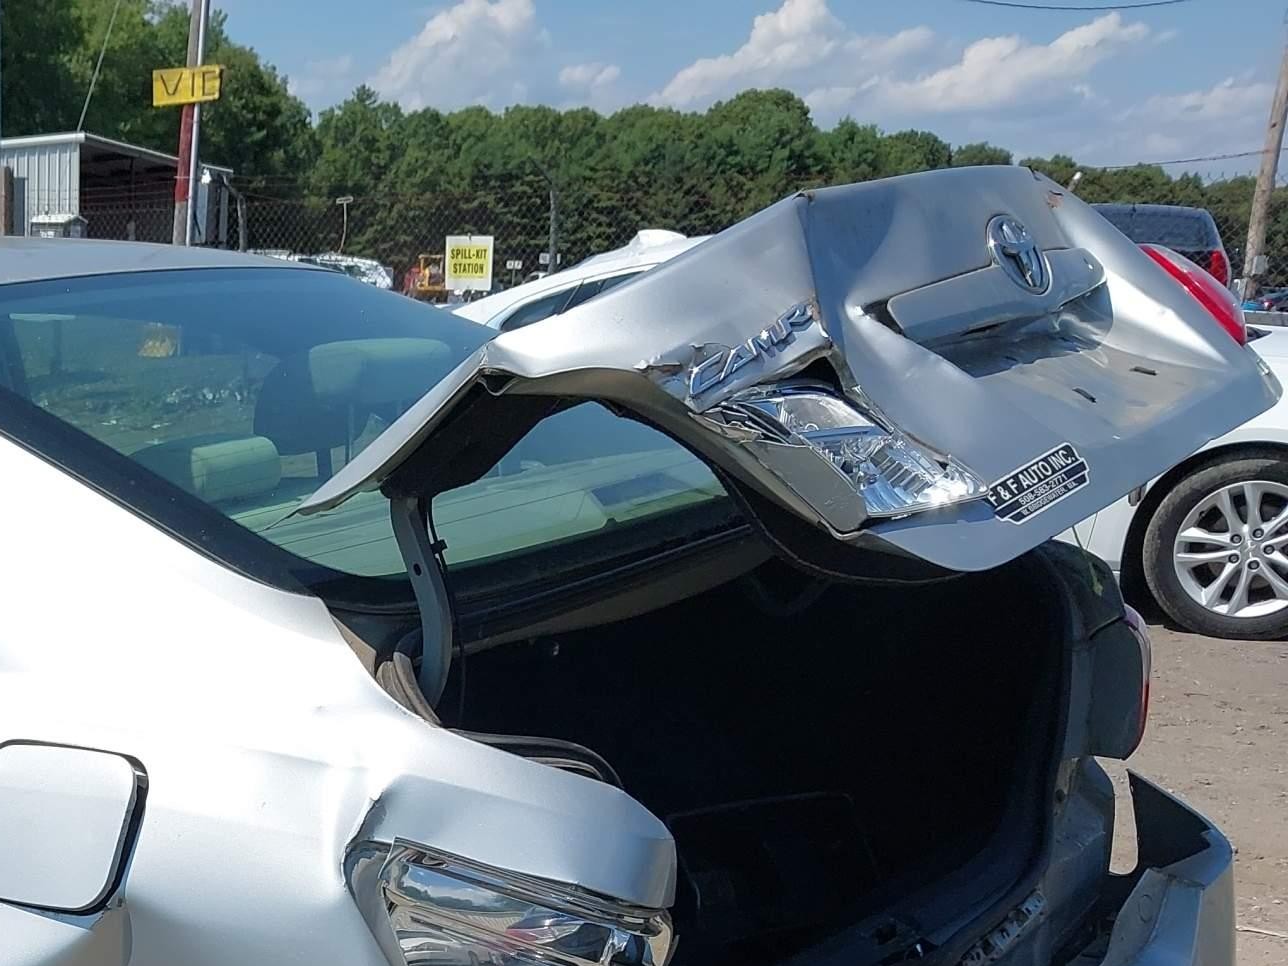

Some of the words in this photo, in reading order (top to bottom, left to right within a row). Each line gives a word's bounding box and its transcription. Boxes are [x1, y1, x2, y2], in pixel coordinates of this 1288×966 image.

[450, 248, 488, 260] SPILL-KIT
[452, 260, 484, 274] STATION
[690, 303, 814, 397] CAMR
[987, 491, 998, 506] F
[998, 485, 1012, 500] &
[1006, 479, 1019, 494] F
[1018, 461, 1052, 489] AUTO
[1047, 449, 1076, 472] INC.
[1018, 474, 1068, 505] 508-583-2771
